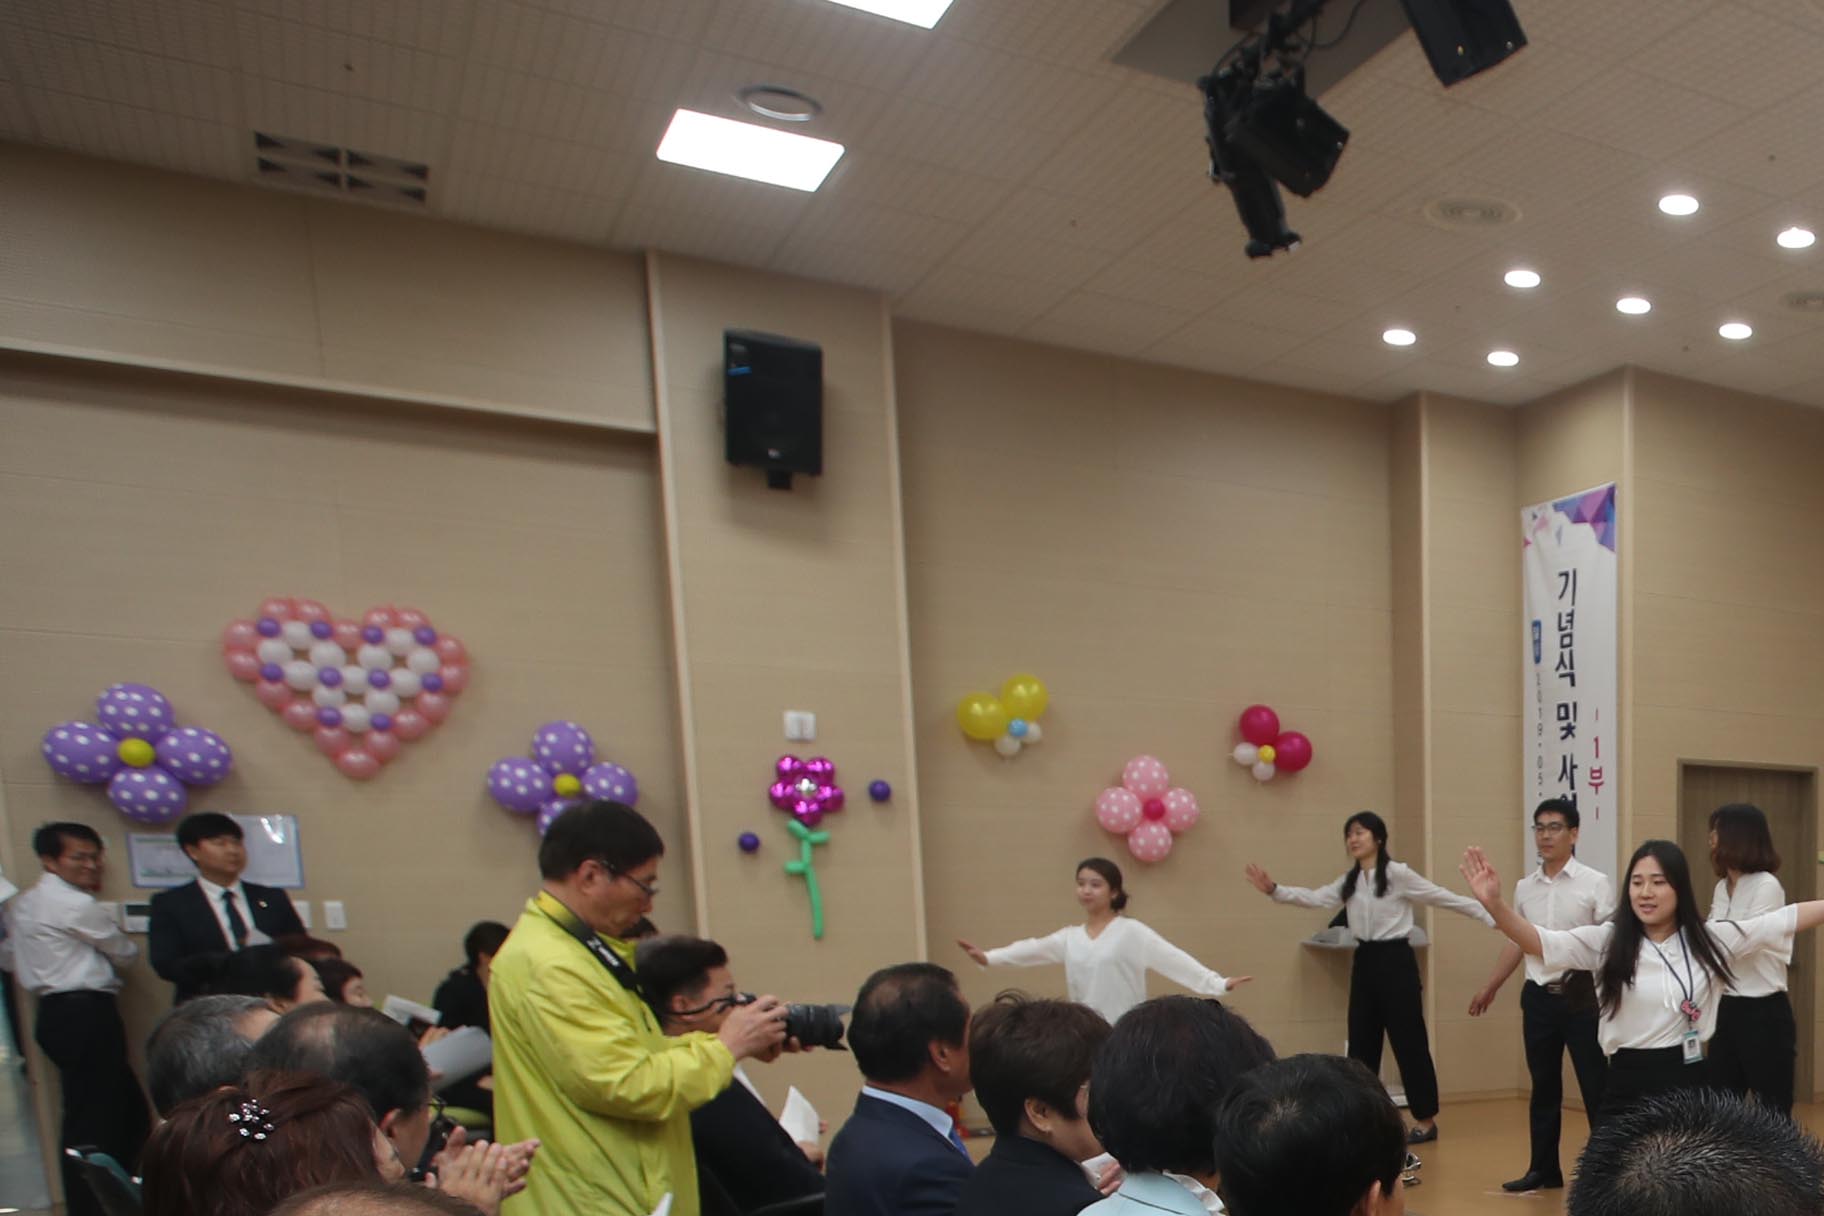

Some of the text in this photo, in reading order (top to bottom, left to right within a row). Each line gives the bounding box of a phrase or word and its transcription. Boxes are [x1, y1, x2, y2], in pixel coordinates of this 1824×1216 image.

[1554, 567, 1577, 687] 기념식
[1556, 701, 1577, 741] 및
[1588, 736, 1604, 795] 1부
